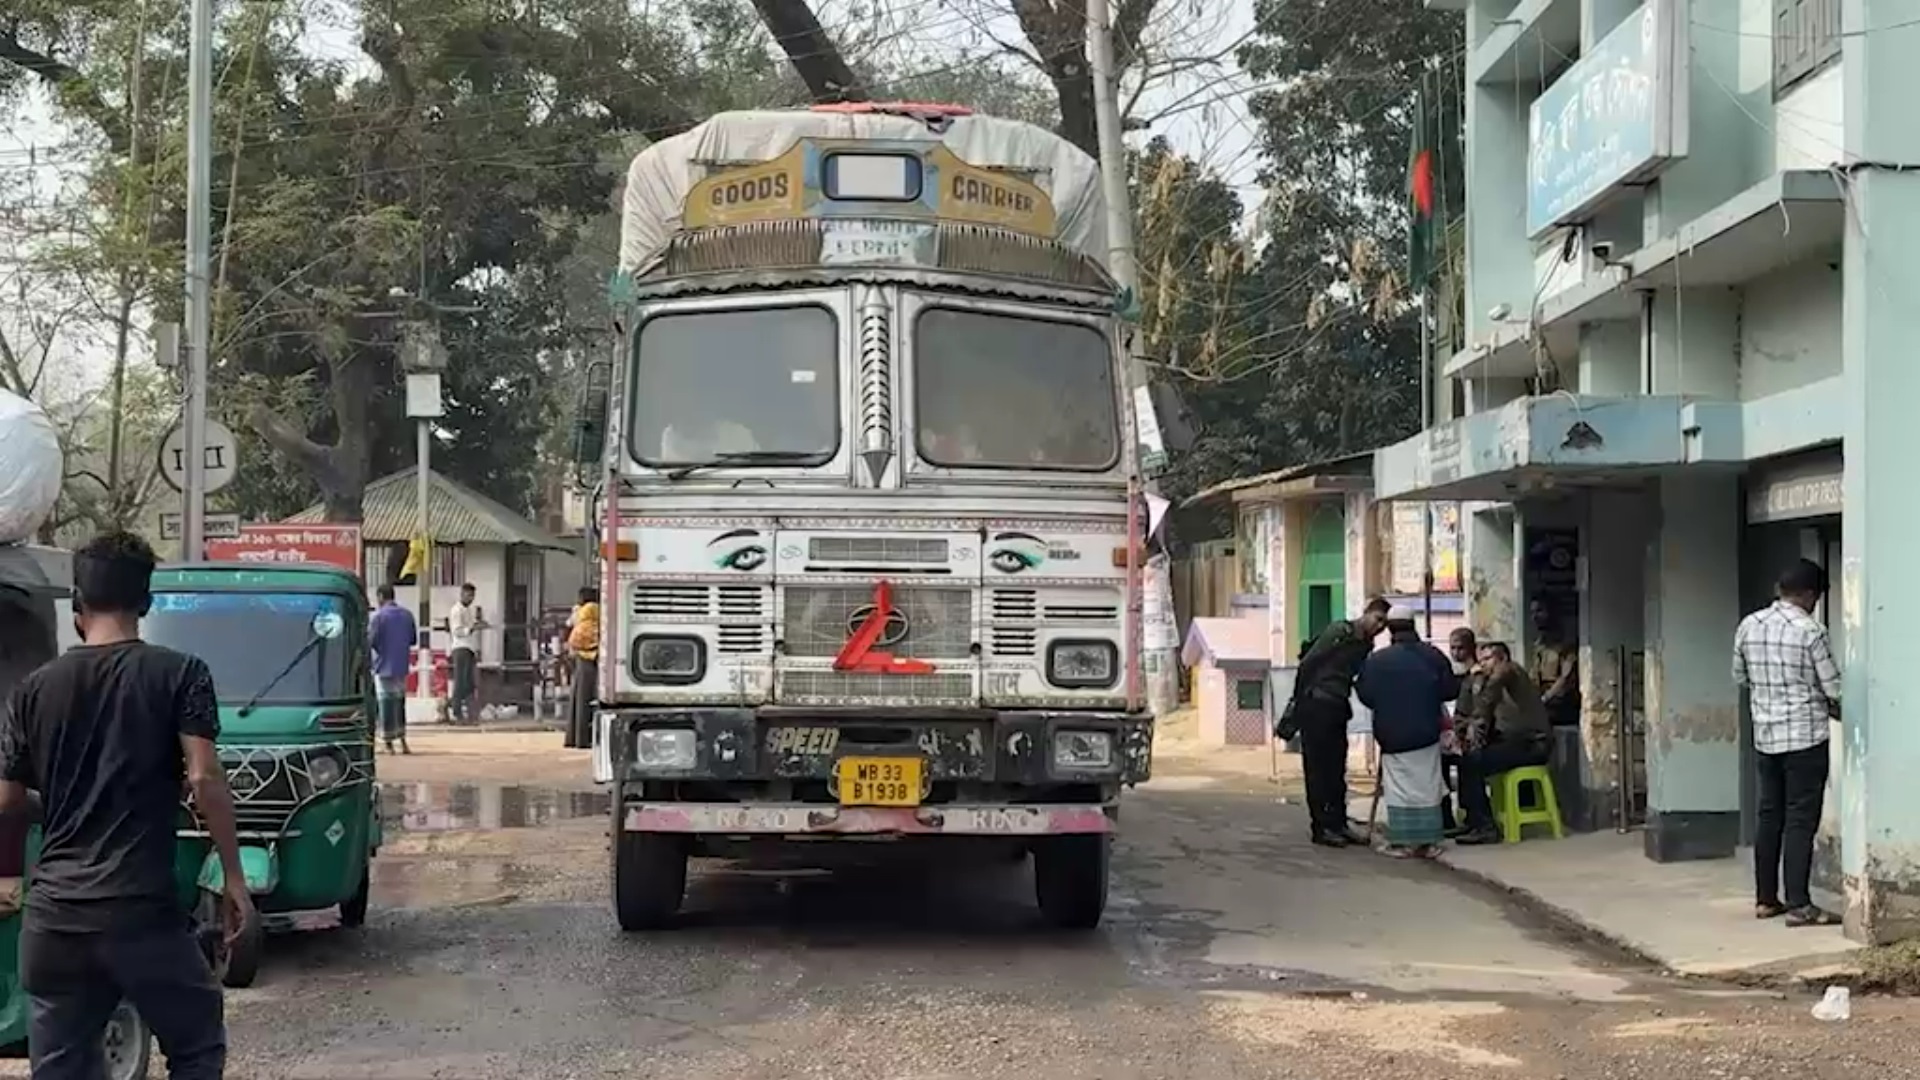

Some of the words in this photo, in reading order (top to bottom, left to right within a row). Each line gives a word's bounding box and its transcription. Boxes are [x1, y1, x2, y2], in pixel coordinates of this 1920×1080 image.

[711, 172, 789, 206] GOODS
[952, 175, 1035, 213] CARRIER
[765, 727, 840, 755] SPEED
[857, 764, 878, 781] WB
[883, 764, 902, 781] 33
